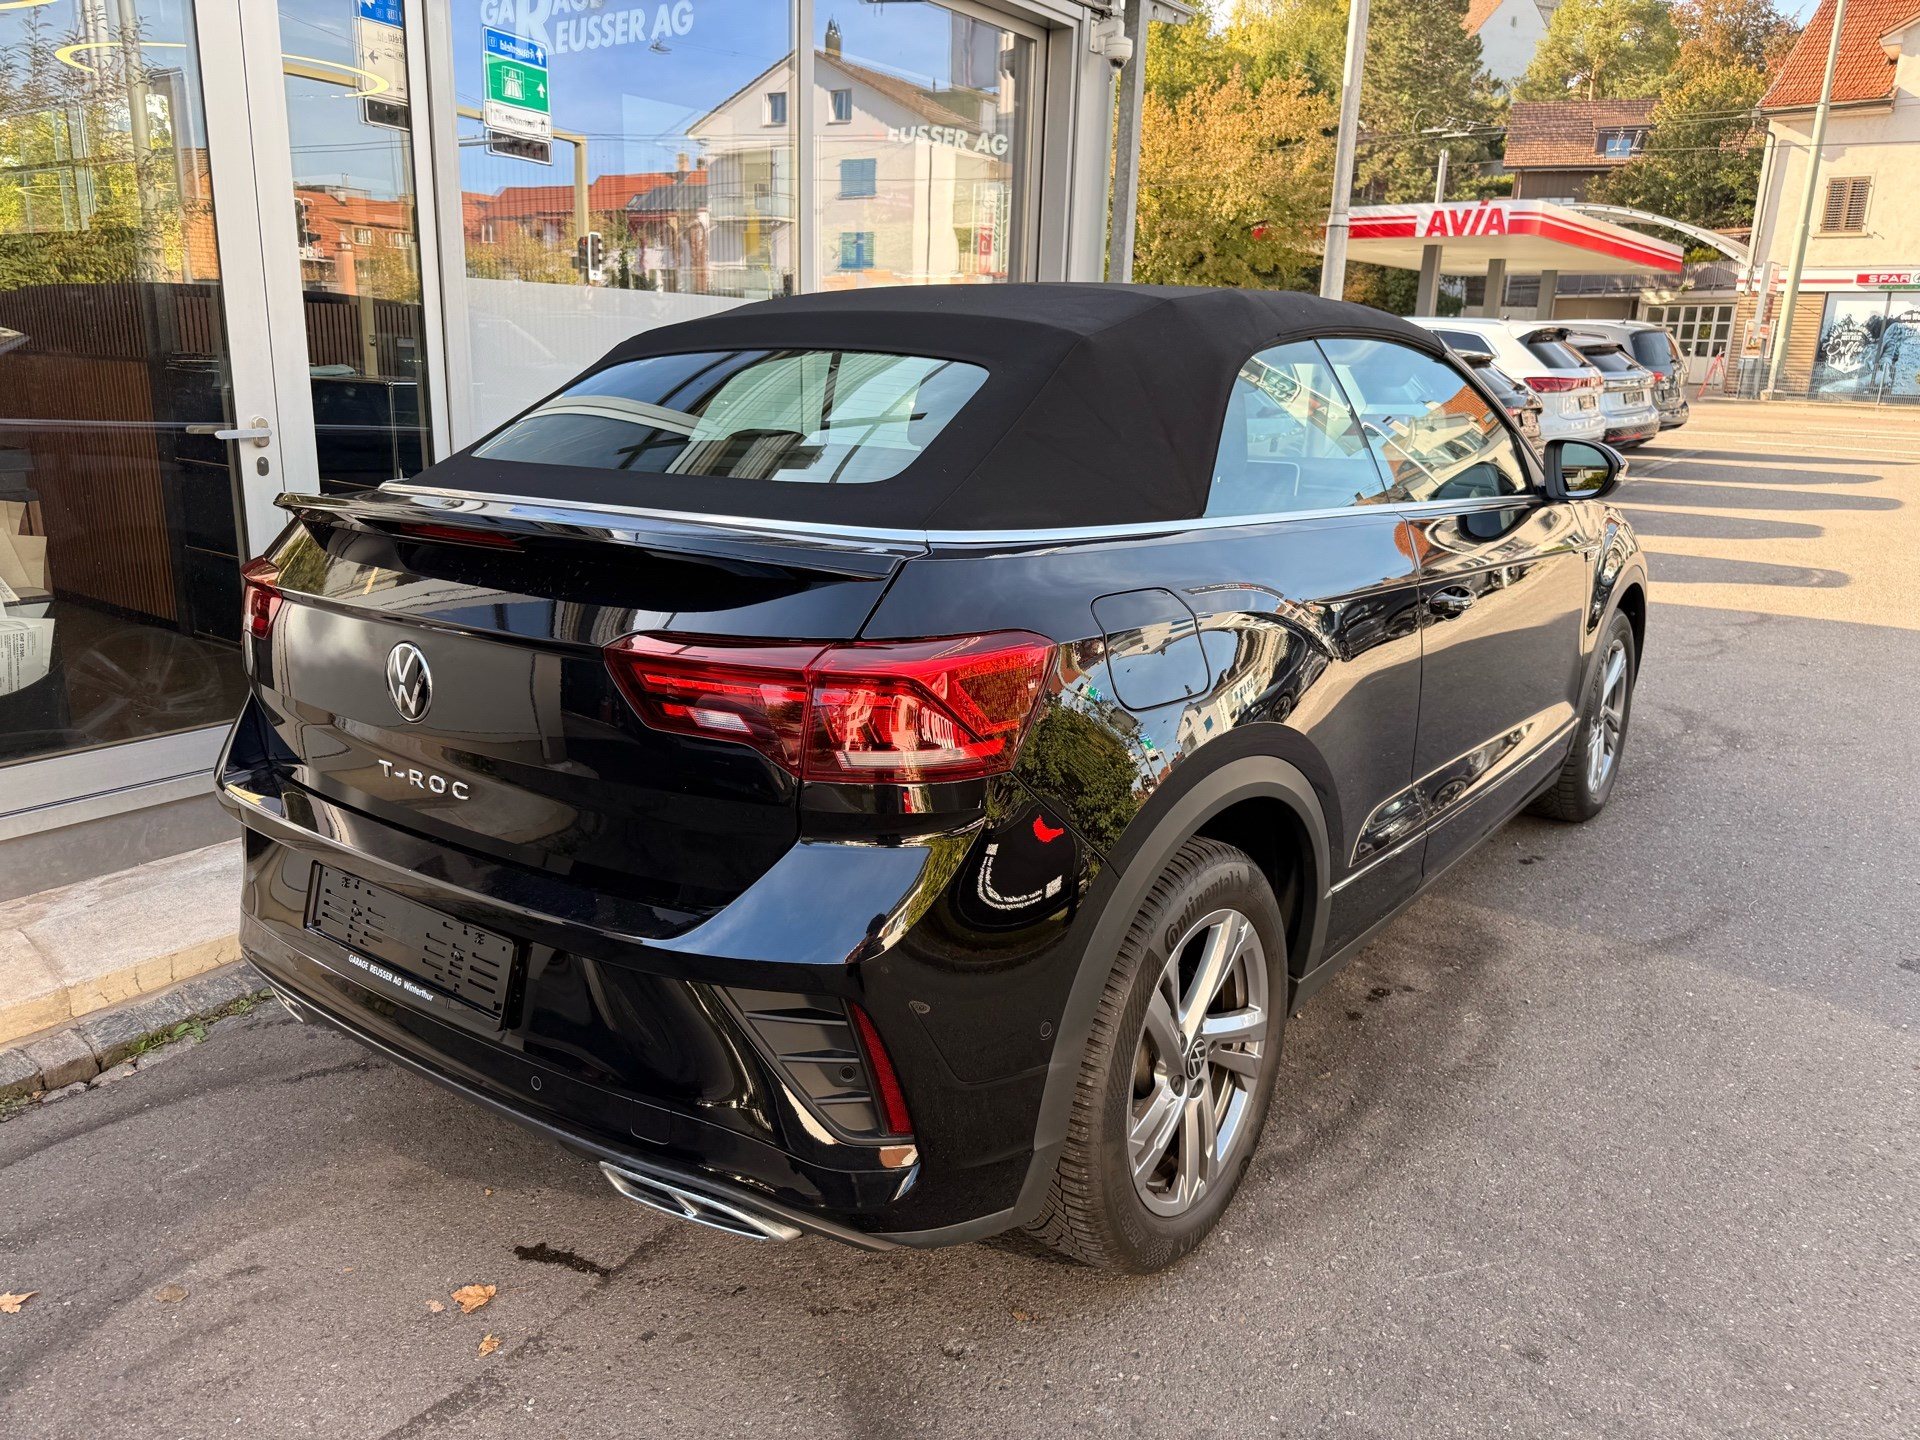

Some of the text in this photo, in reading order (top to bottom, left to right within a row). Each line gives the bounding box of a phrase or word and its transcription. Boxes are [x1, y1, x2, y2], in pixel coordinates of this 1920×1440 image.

[651, 3, 694, 40] AG
[974, 133, 1009, 156] AG
[1425, 199, 1506, 237] AVIA
[1868, 274, 1910, 283] SPAR
[378, 759, 469, 801] T-ROC
[1165, 870, 1235, 955] Continental
[348, 954, 434, 1002] GARAGE REUSSER AG Winterthur
